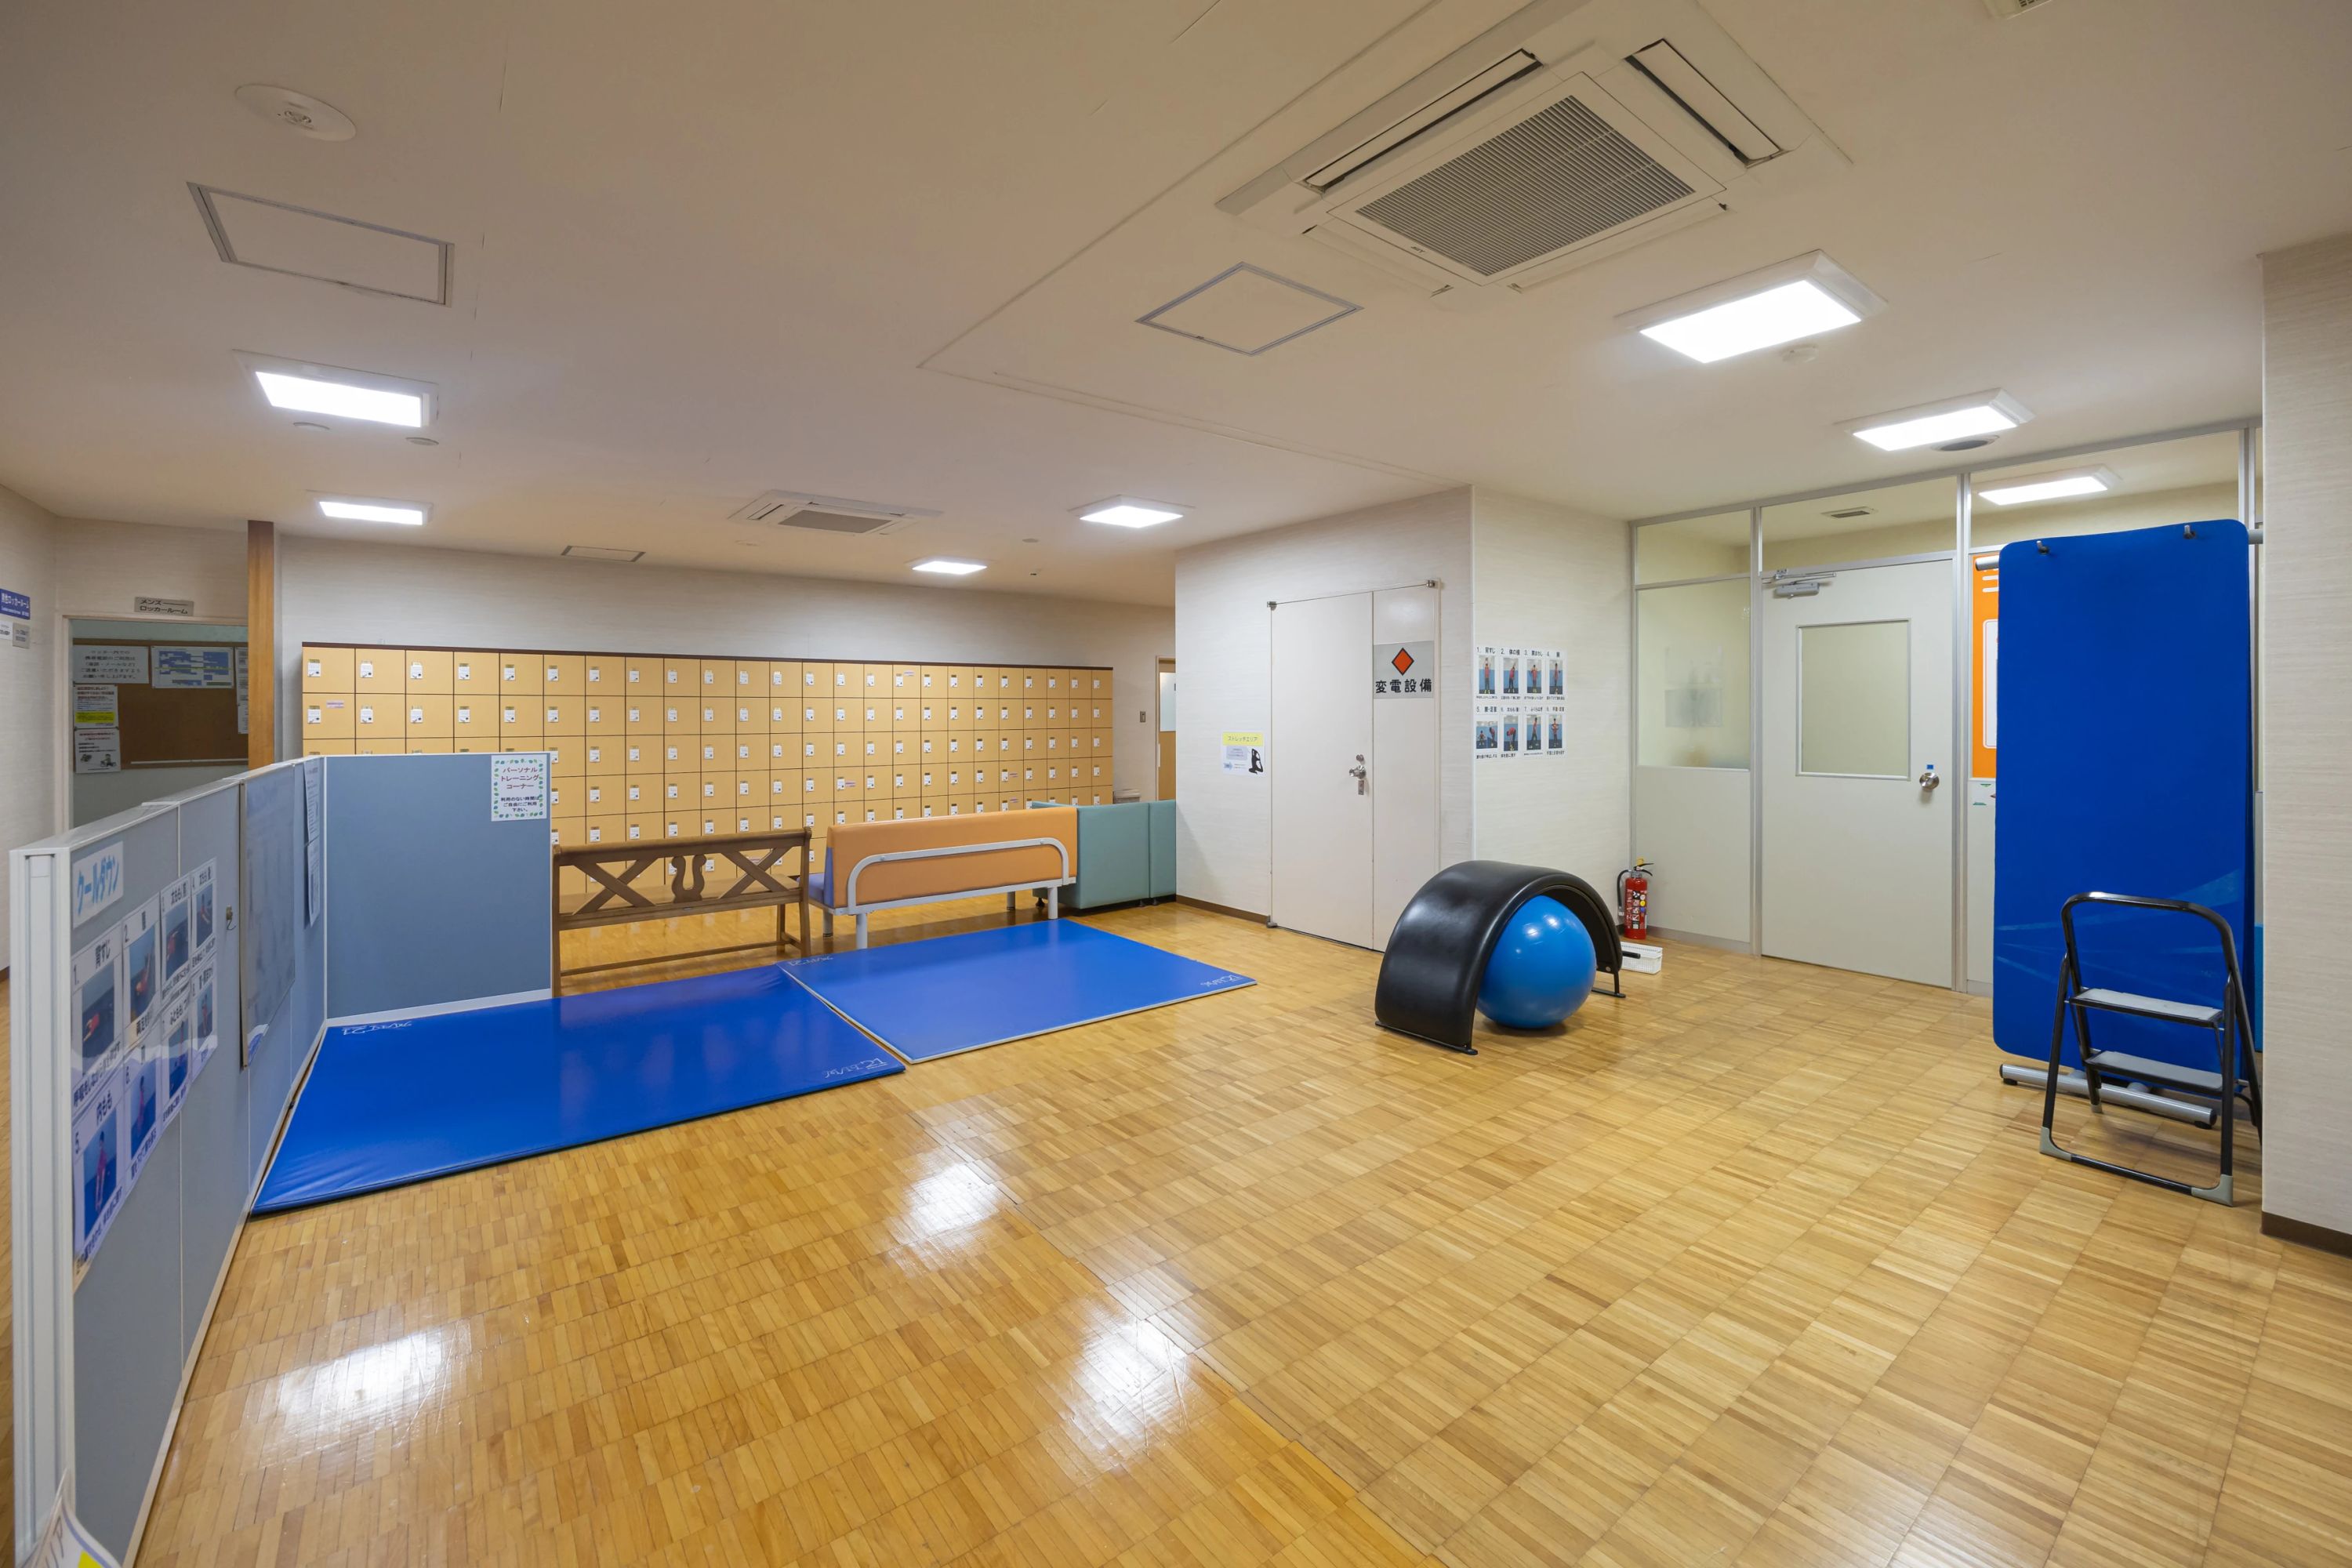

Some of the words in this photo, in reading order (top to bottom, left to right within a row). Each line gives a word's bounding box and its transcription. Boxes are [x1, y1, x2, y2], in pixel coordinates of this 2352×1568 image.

[1375, 678, 1432, 694] 変電設備
[77, 855, 119, 916] クールダウン
